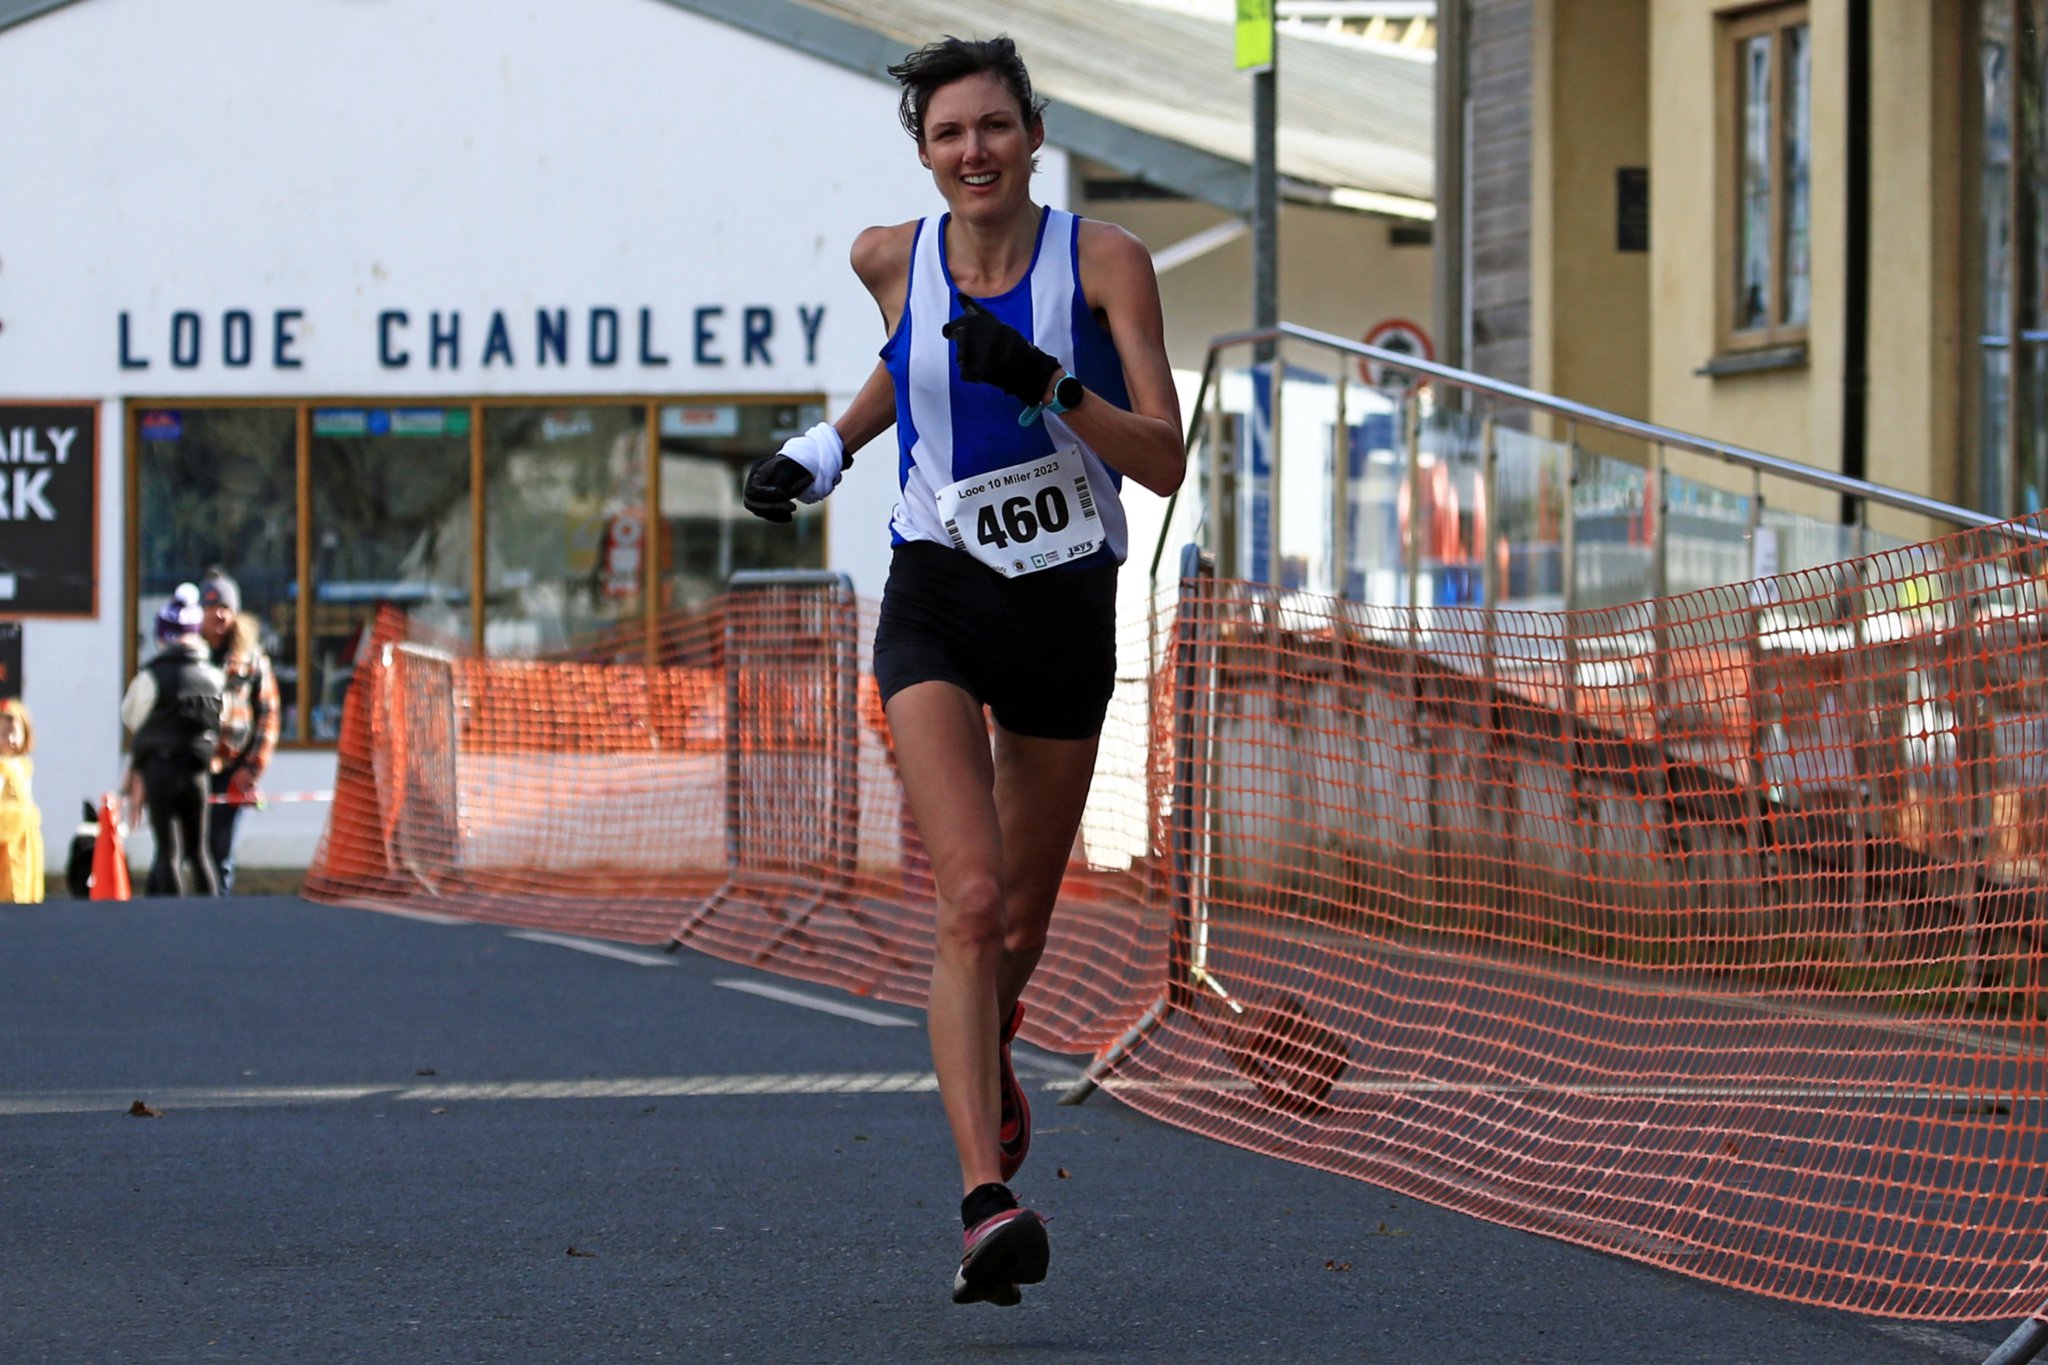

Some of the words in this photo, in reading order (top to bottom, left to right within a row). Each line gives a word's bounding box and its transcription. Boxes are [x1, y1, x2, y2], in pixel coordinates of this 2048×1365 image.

[118, 309, 303, 370] LOOE
[377, 305, 826, 369] CHANDLERY
[957, 485, 986, 500] Looe
[988, 478, 1001, 490] 10
[1003, 472, 1032, 486] Miler
[1033, 461, 1060, 478] 2023
[976, 485, 1070, 550] 460
